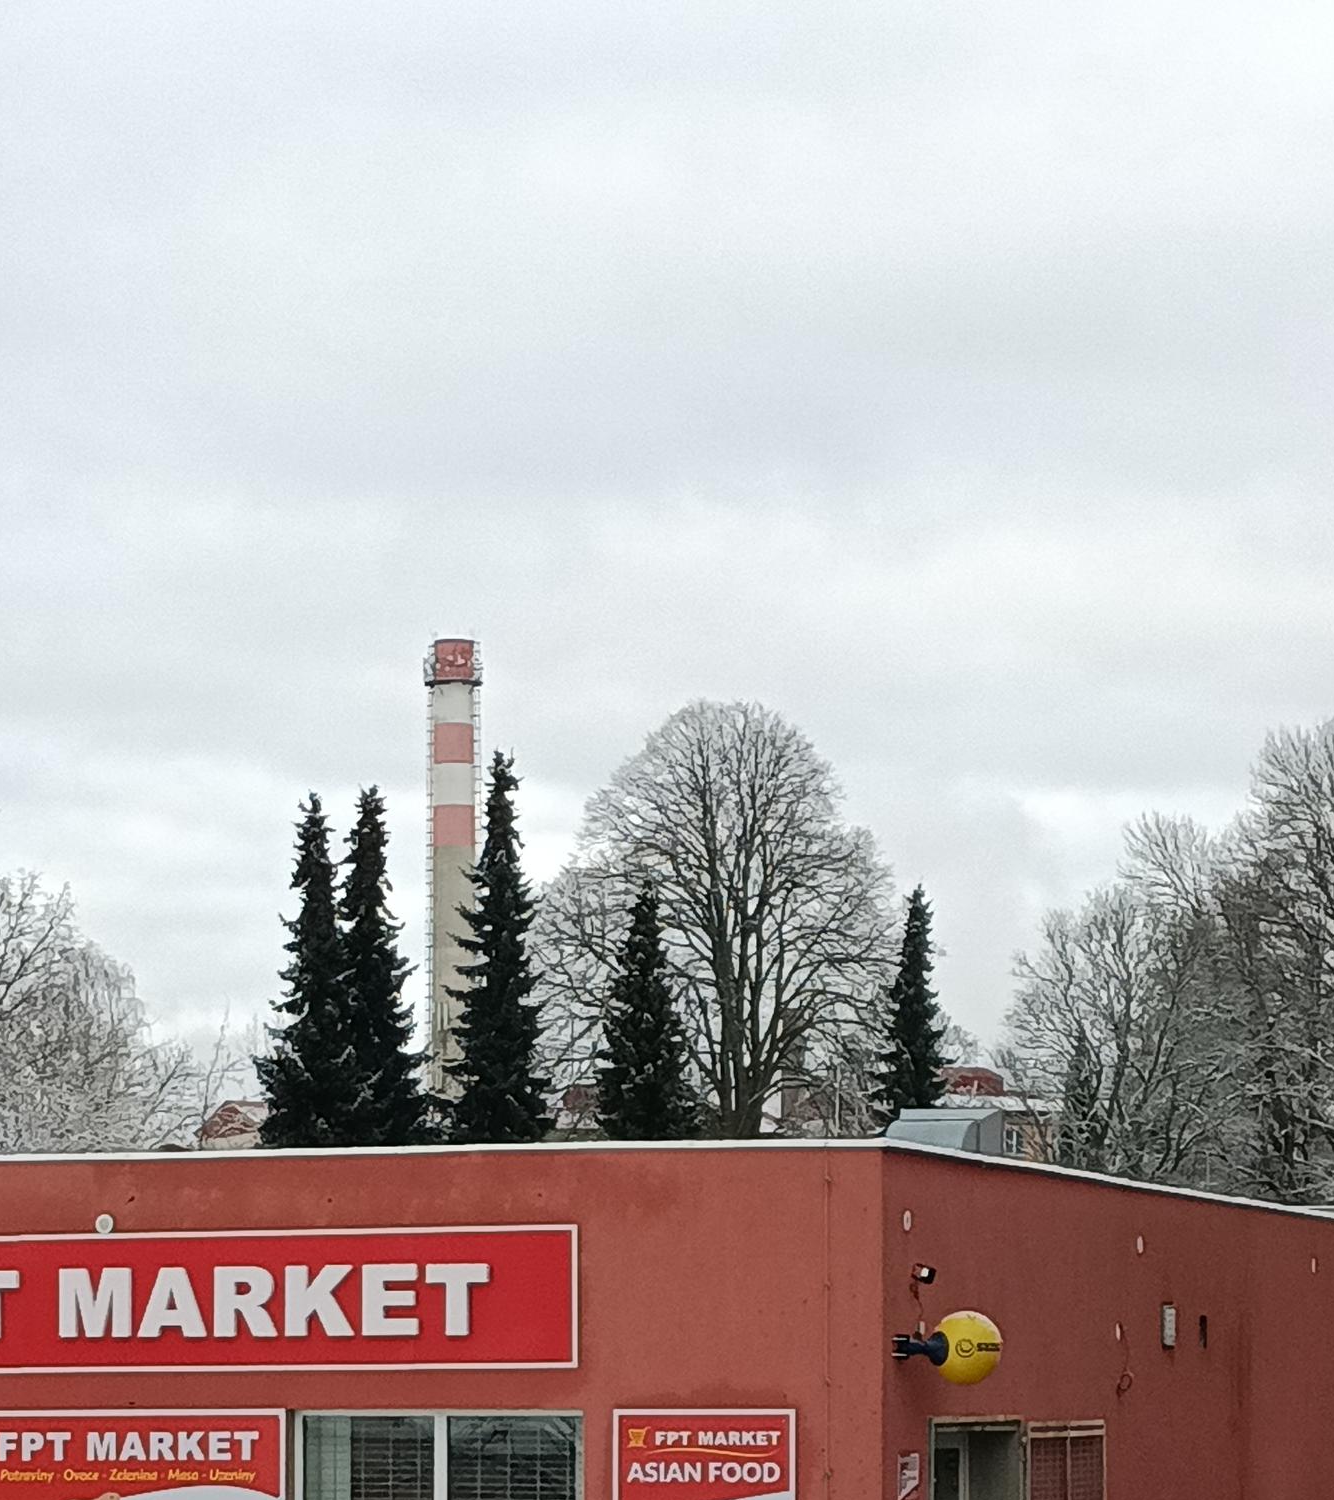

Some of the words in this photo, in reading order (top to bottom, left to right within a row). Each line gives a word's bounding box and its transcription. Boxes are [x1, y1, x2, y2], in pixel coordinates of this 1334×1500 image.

[57, 1262, 491, 1340] MARKET
[86, 1430, 259, 1461] MARKET
[655, 1431, 692, 1446] FPT
[697, 1431, 781, 1446] MARKET
[627, 1462, 702, 1483] ASIAN
[708, 1462, 781, 1483] FOOD
